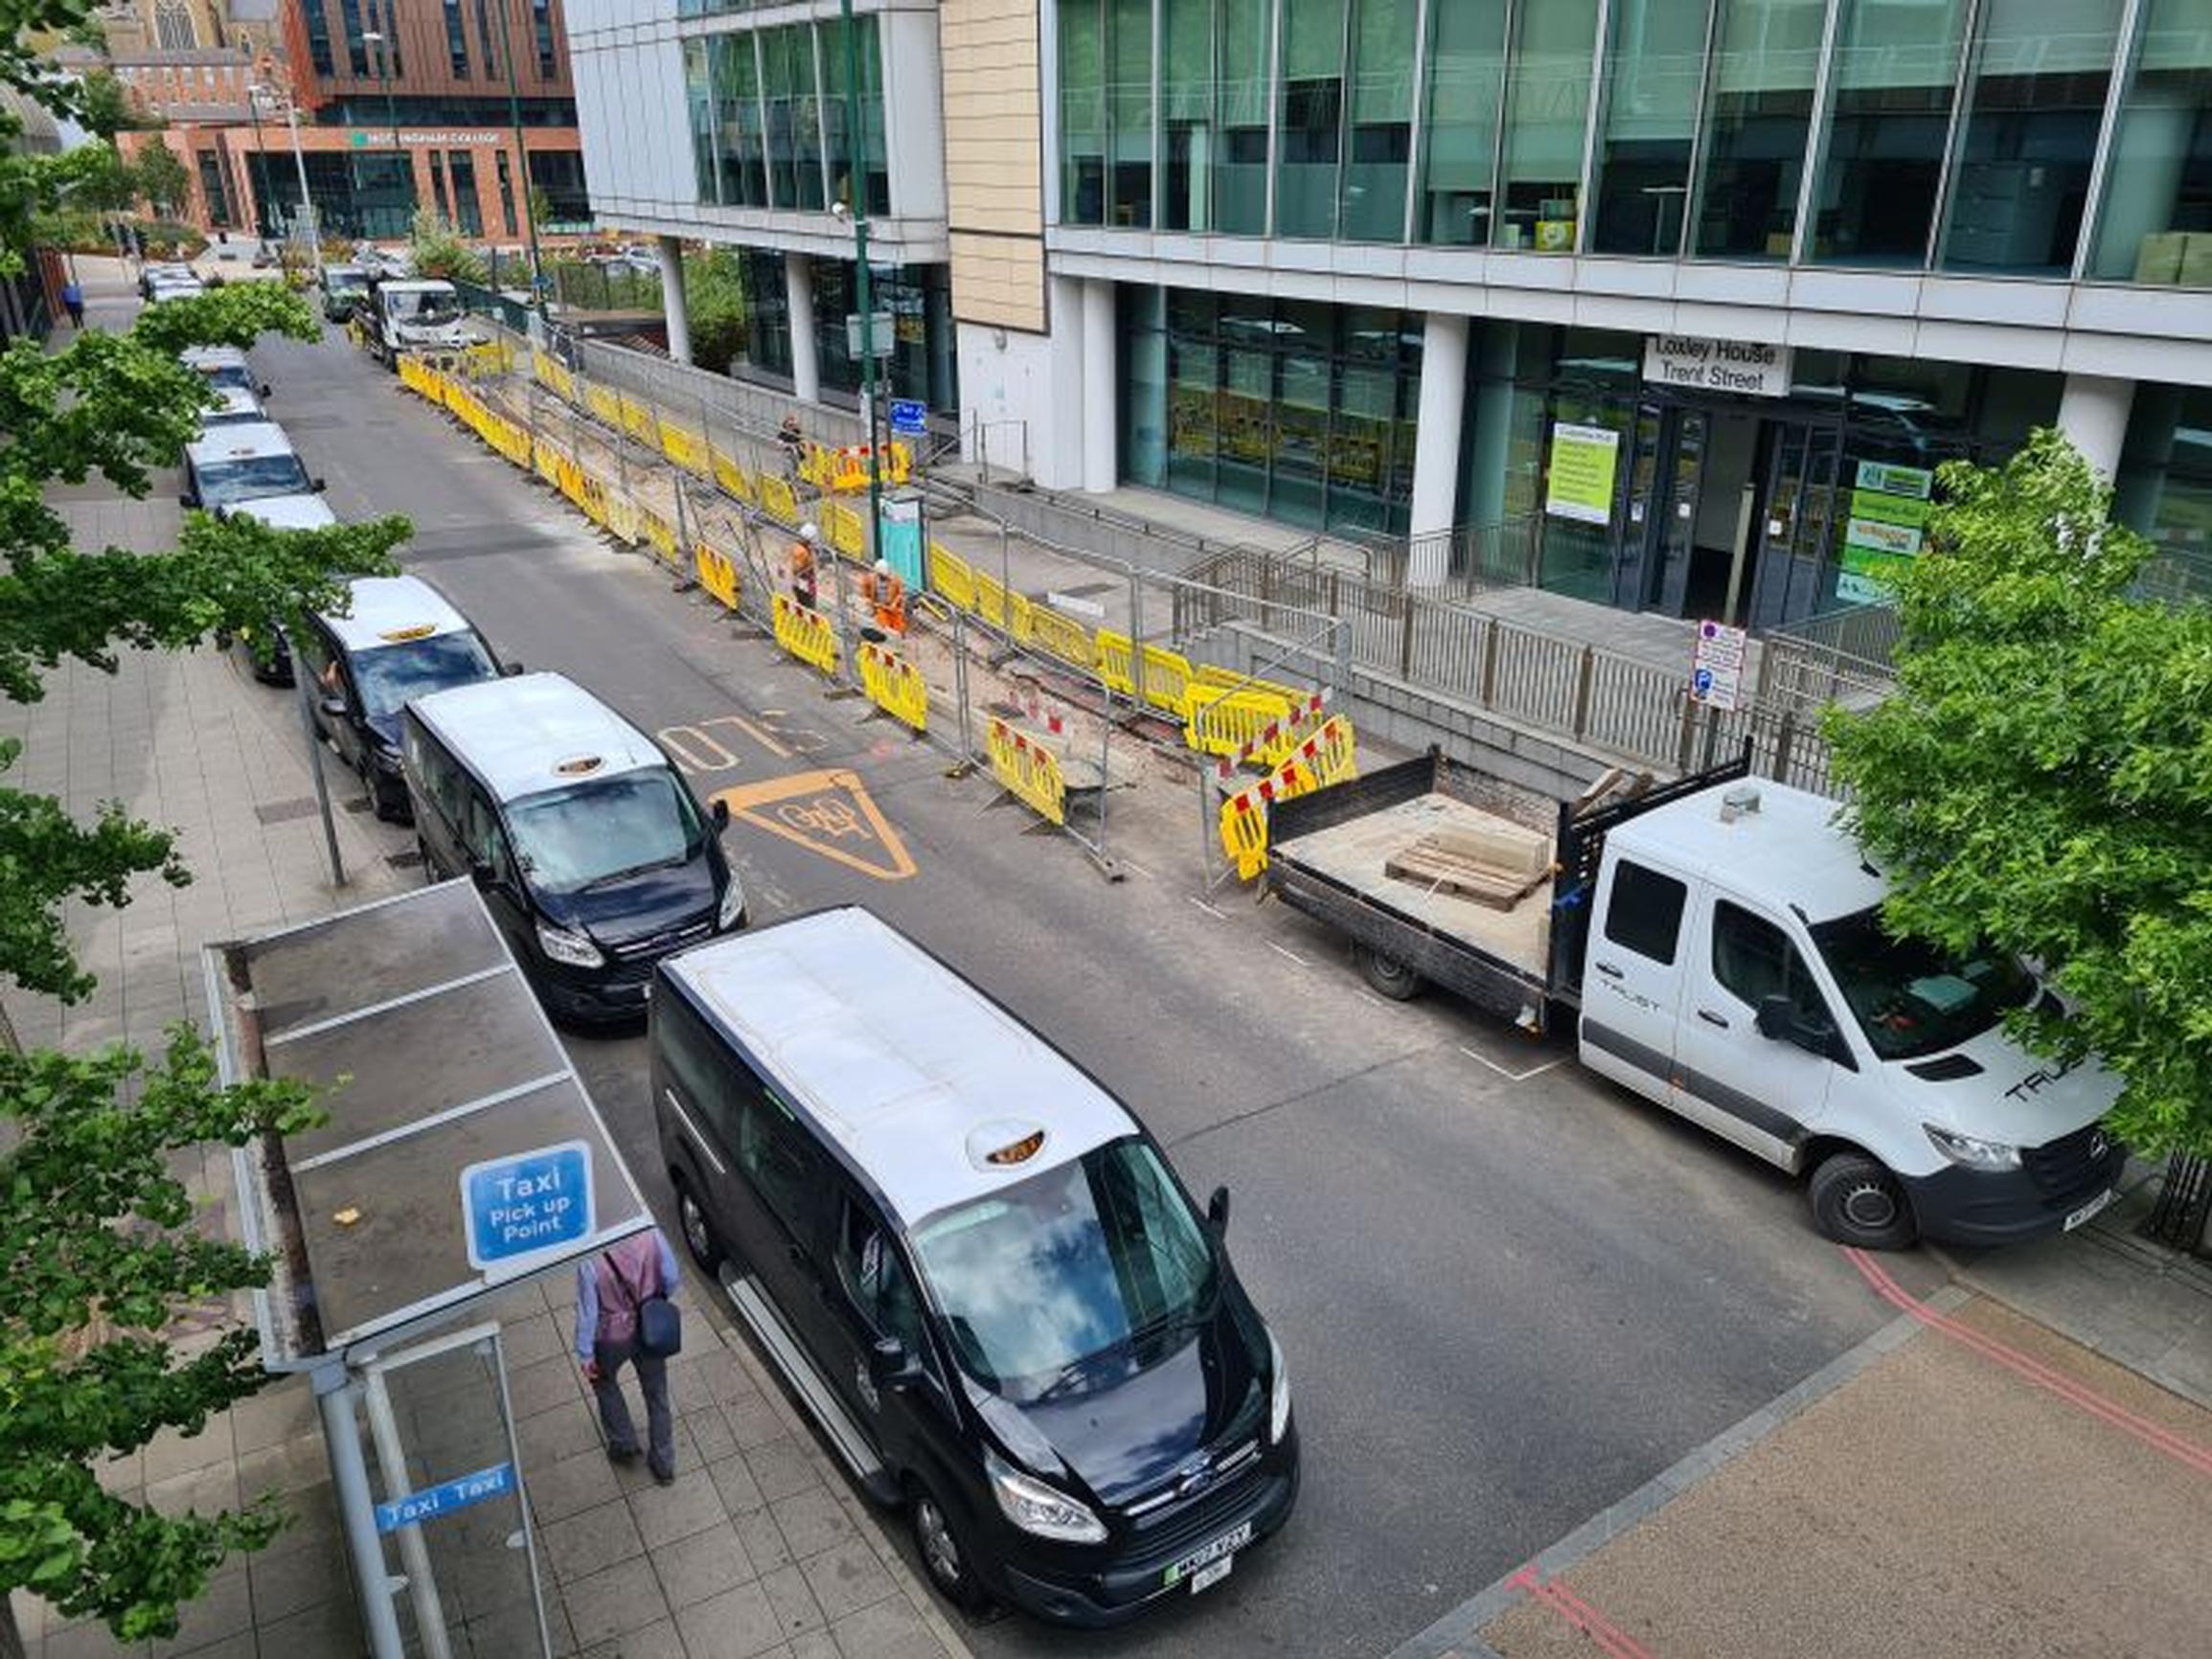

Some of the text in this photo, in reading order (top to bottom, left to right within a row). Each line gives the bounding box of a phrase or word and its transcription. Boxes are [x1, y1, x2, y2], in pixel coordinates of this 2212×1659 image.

[1655, 336, 1776, 366] Loxley House
[1662, 359, 1765, 391] Trent Street
[658, 708, 830, 776] SLO
[1600, 977, 1660, 1012] TRUST
[495, 1164, 561, 1202] Taxi
[490, 1196, 571, 1227] Pick up
[503, 1215, 563, 1243] Point
[388, 1469, 506, 1523] Taxi Taxi
